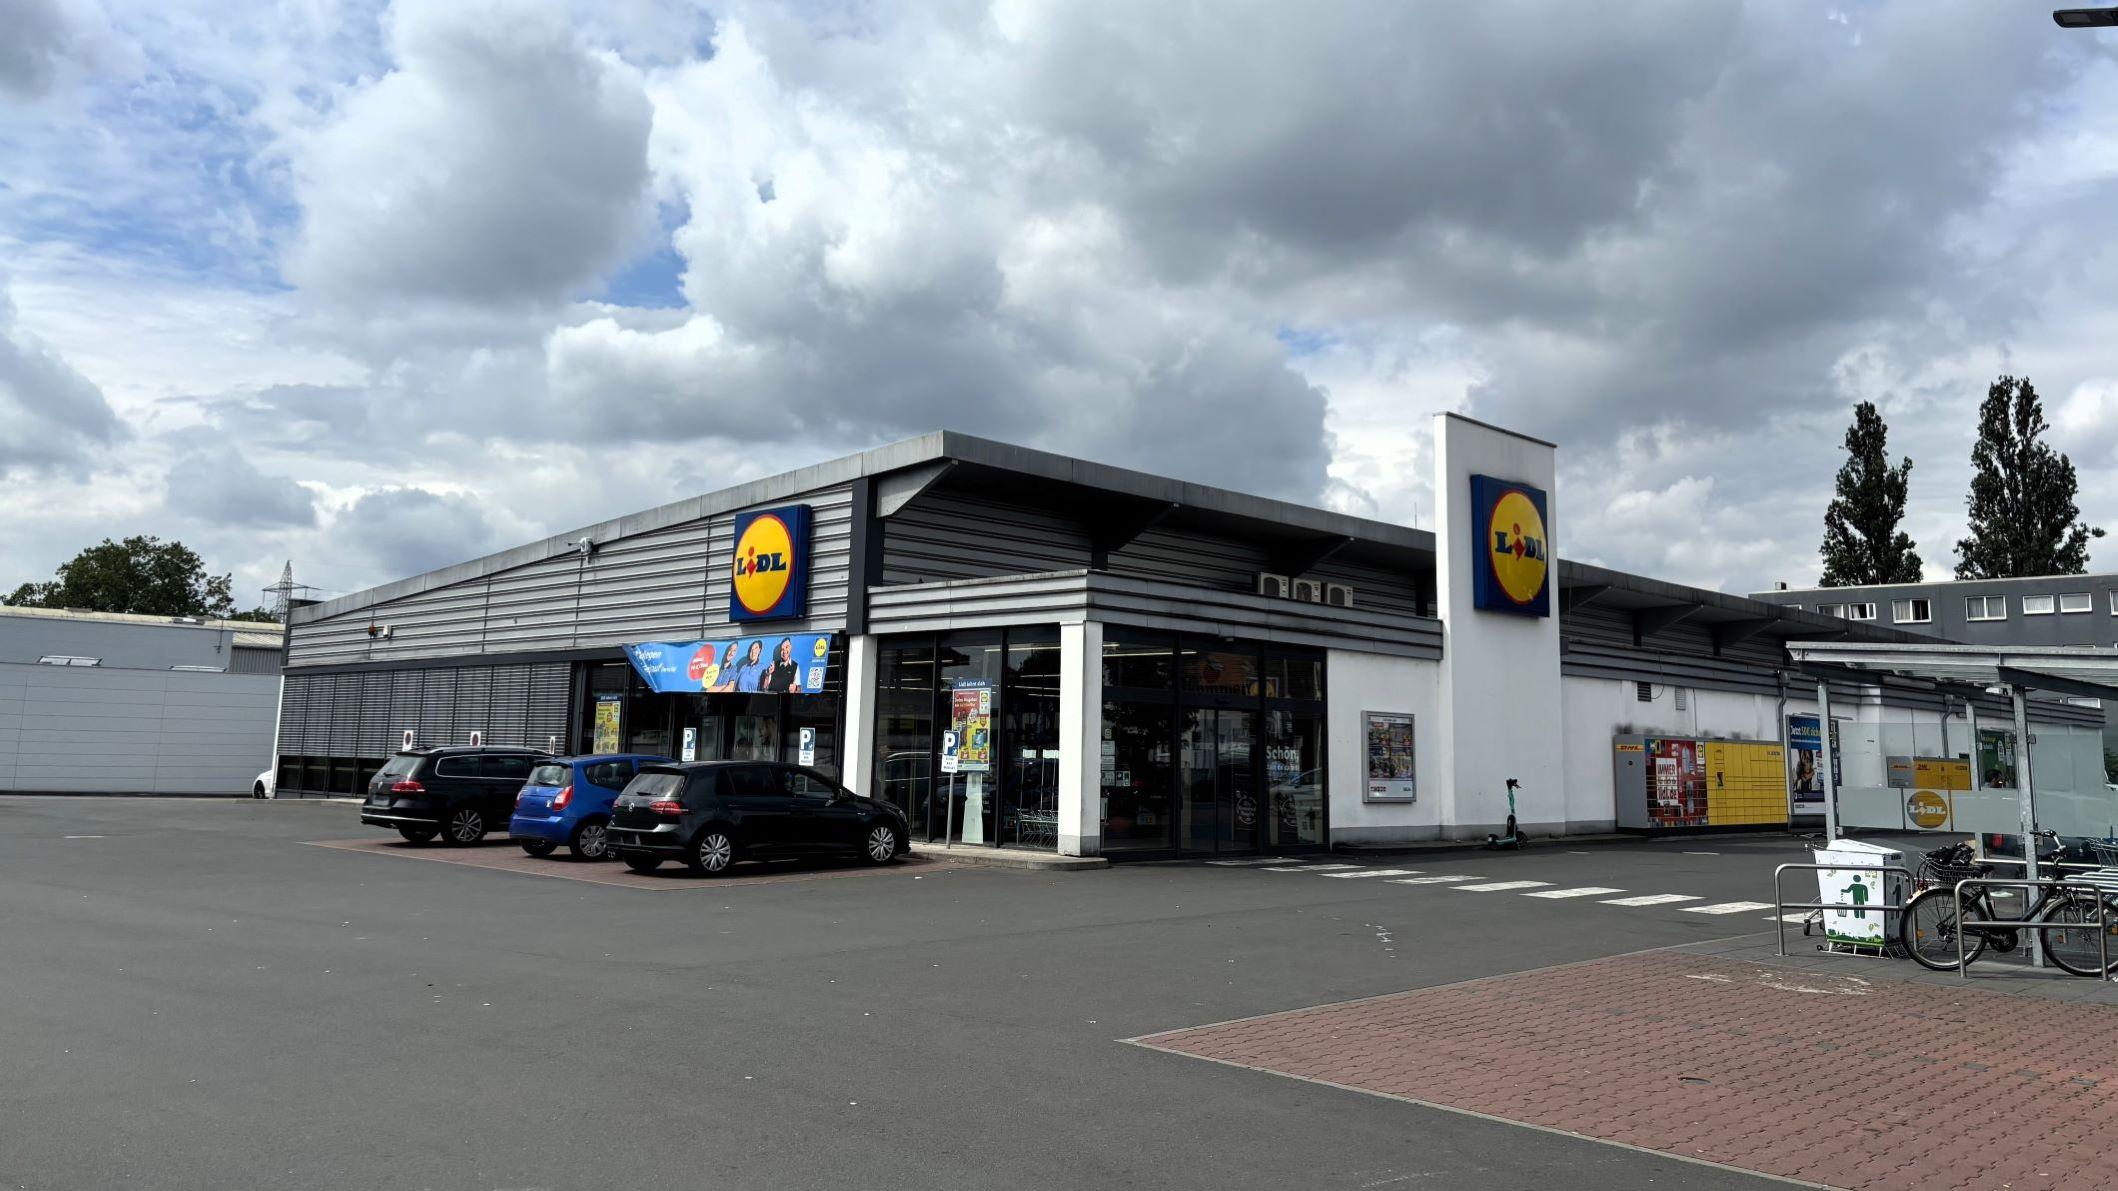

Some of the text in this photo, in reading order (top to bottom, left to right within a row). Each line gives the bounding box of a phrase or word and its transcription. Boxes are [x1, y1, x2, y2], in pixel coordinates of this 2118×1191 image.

[684, 730, 693, 749] P
[800, 728, 812, 750] P
[944, 733, 956, 755] P
